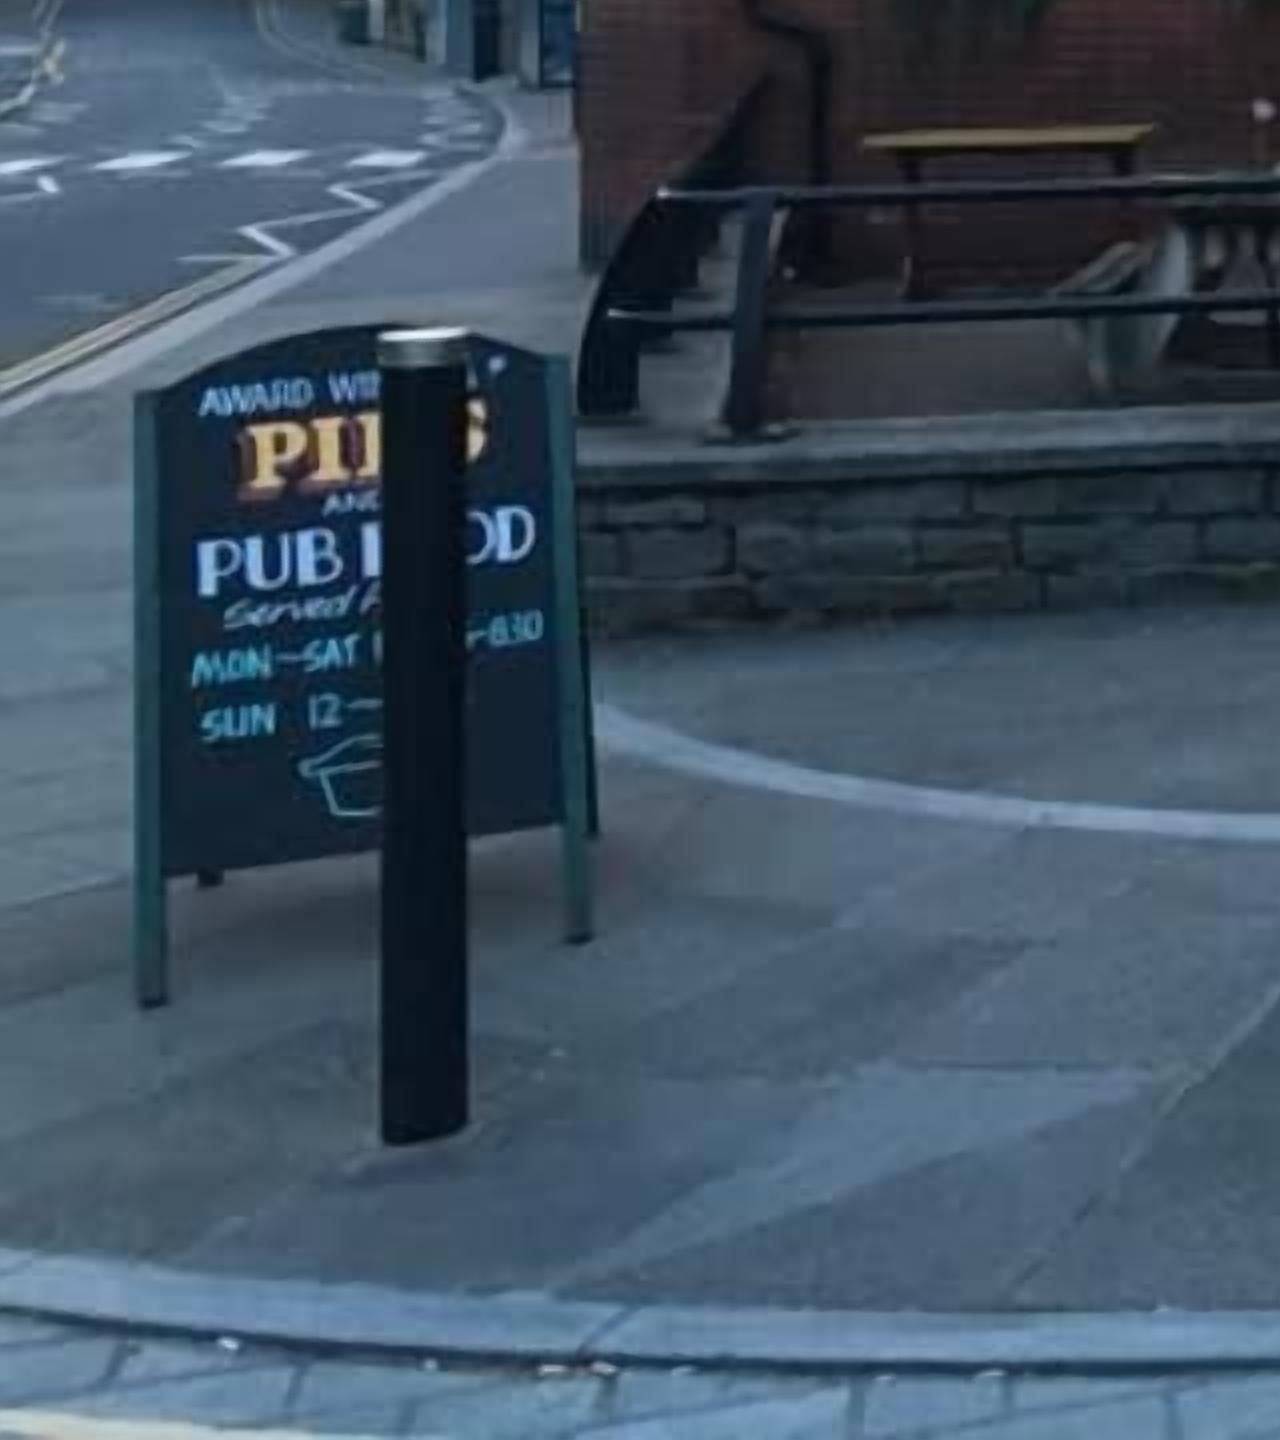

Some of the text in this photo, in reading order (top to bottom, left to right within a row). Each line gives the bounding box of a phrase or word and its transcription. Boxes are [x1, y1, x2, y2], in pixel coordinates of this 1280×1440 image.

[198, 376, 315, 417] AWARD
[197, 526, 344, 597] PUB
[201, 703, 277, 743] SUN
